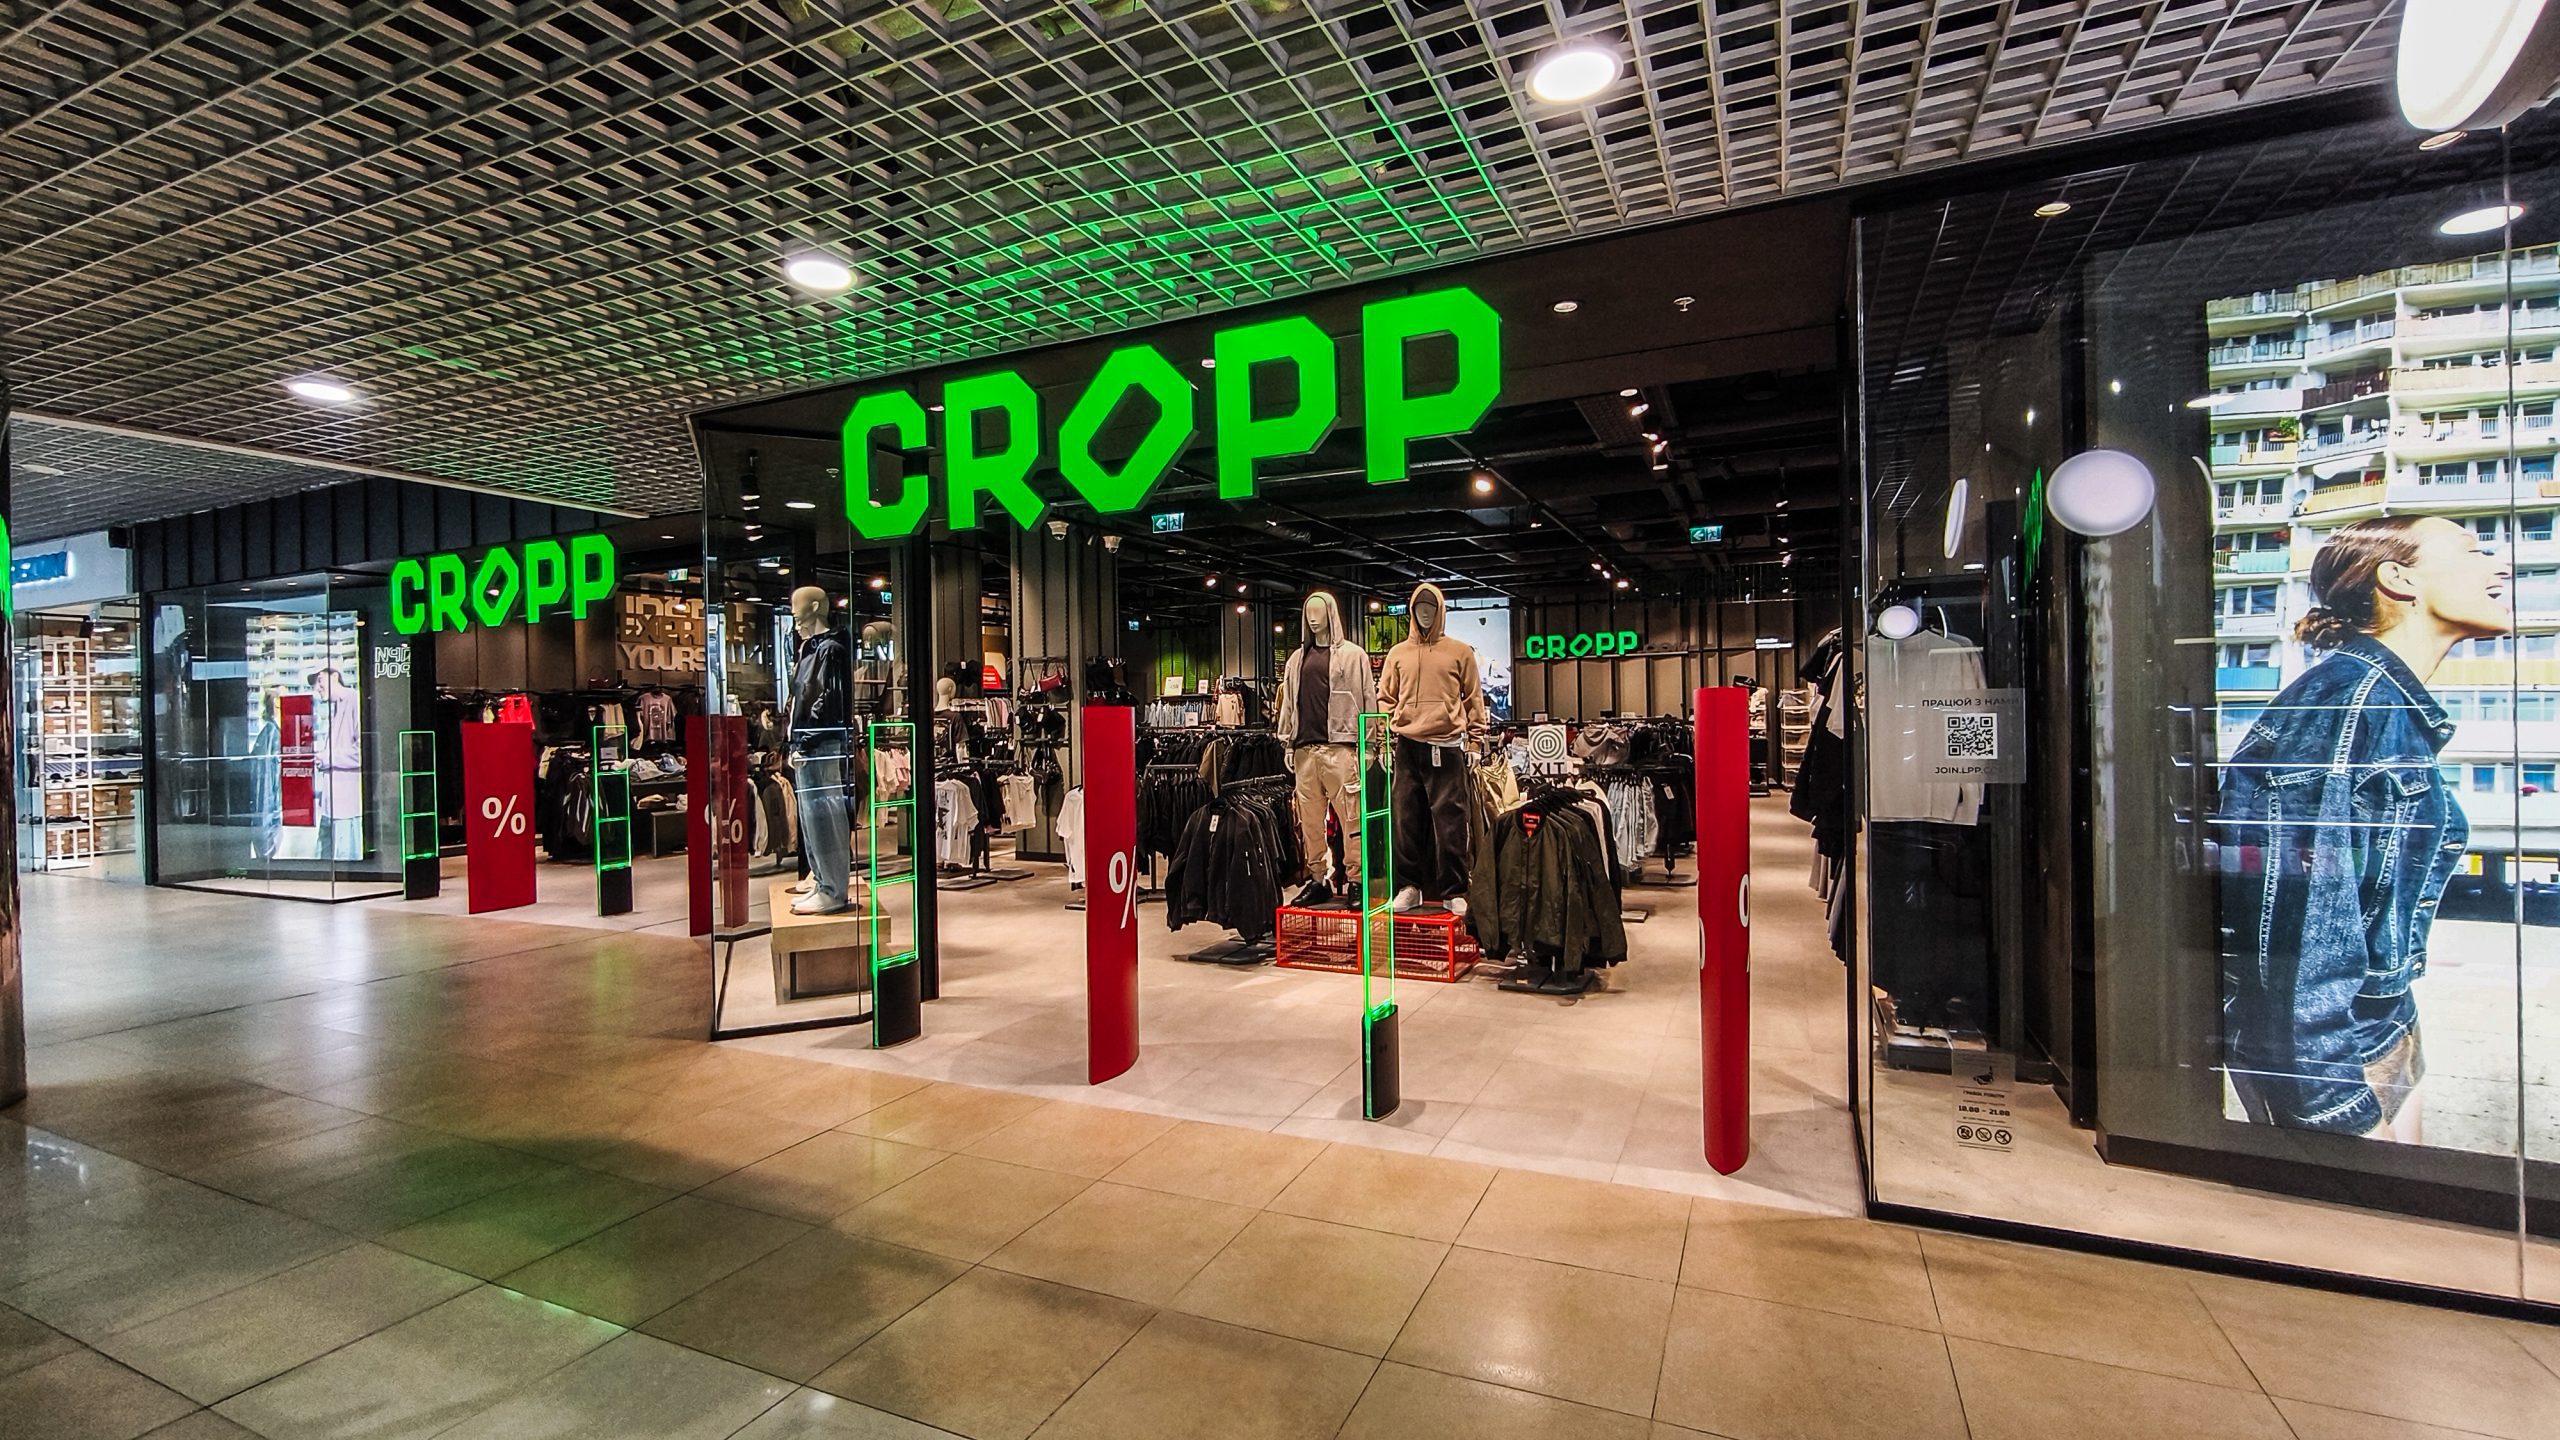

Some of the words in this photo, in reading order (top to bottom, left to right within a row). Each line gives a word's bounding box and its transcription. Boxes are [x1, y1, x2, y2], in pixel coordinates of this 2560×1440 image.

[842, 286, 1502, 540] CROPP
[392, 534, 615, 634] CROPP
[1526, 631, 1638, 658] CROPP
[1921, 698, 1972, 707] ПРАЦЮЙ
[1985, 698, 2019, 706] НАМИ
[1531, 761, 1565, 775] XIT
[482, 795, 526, 837] %
